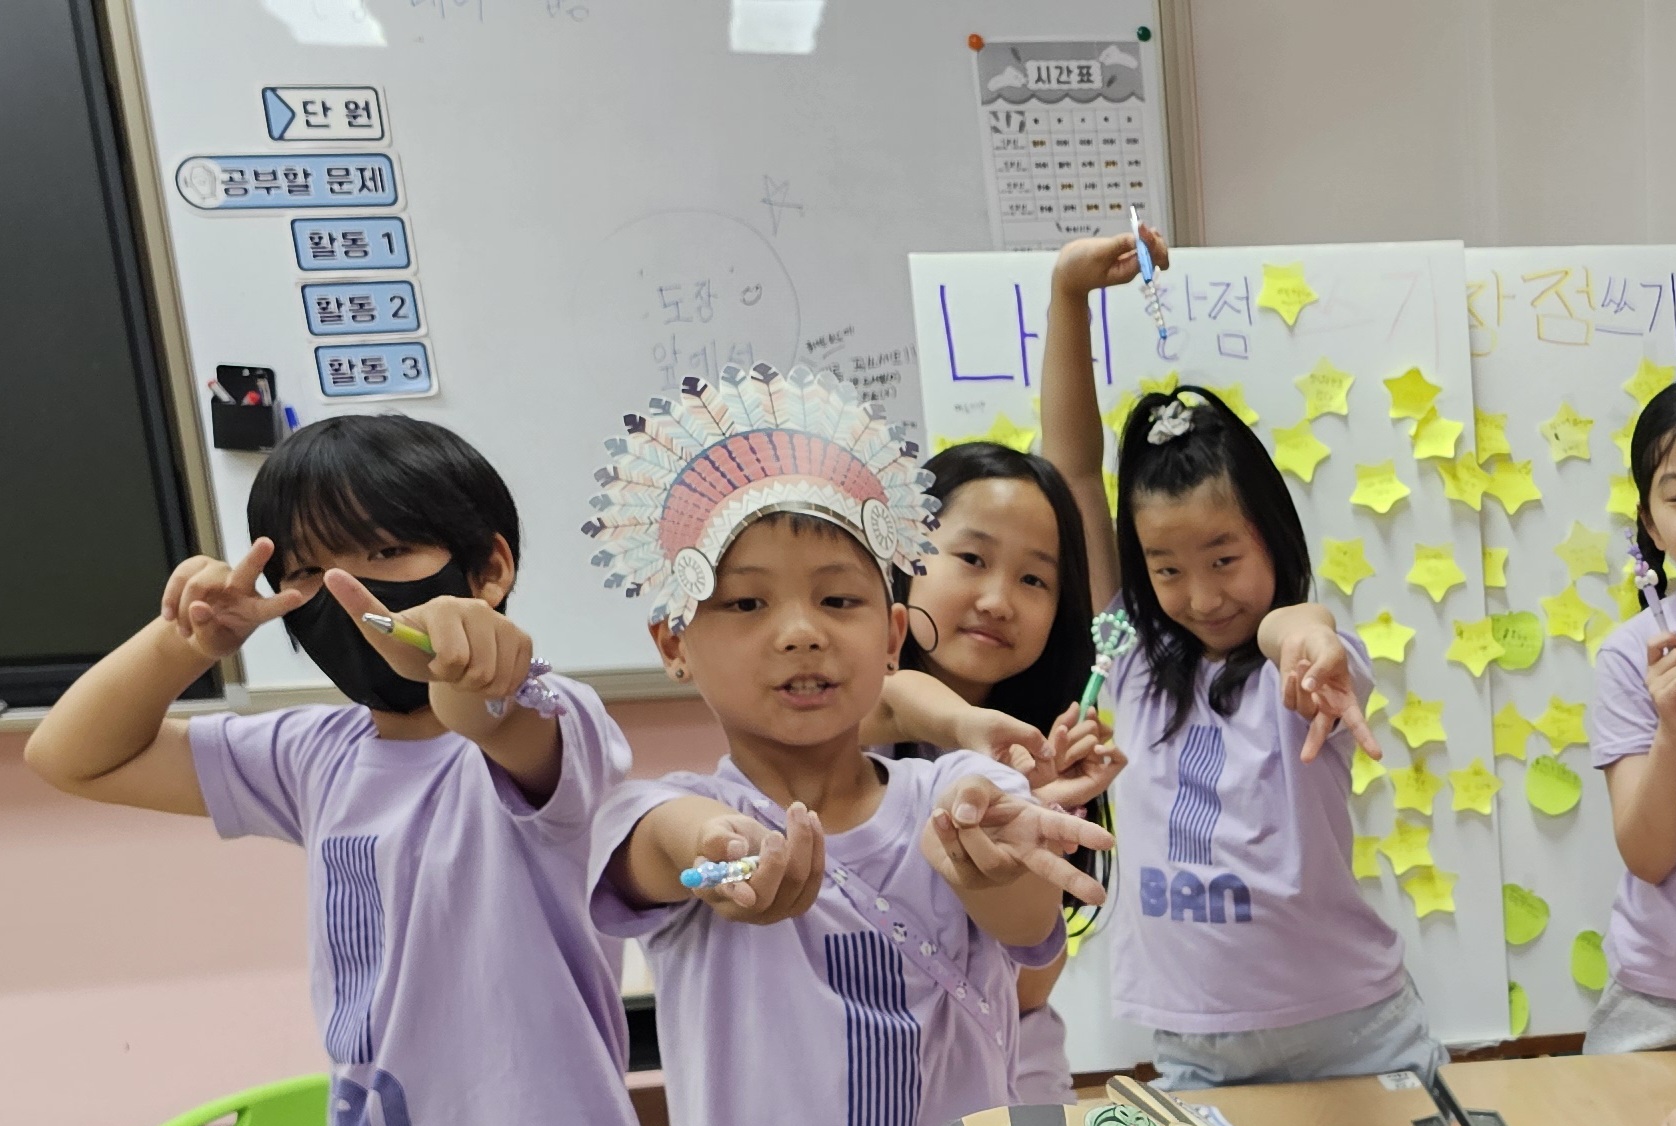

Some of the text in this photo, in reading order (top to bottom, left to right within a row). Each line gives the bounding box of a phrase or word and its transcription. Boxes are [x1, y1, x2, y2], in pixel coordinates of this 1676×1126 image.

[1034, 65, 1095, 85] 시간표
[221, 165, 386, 197] 공부할 문제
[309, 230, 396, 260] 활동 1
[316, 295, 409, 325] 활동 2
[328, 356, 422, 386] 활동 3
[1139, 866, 1253, 924] BAN
